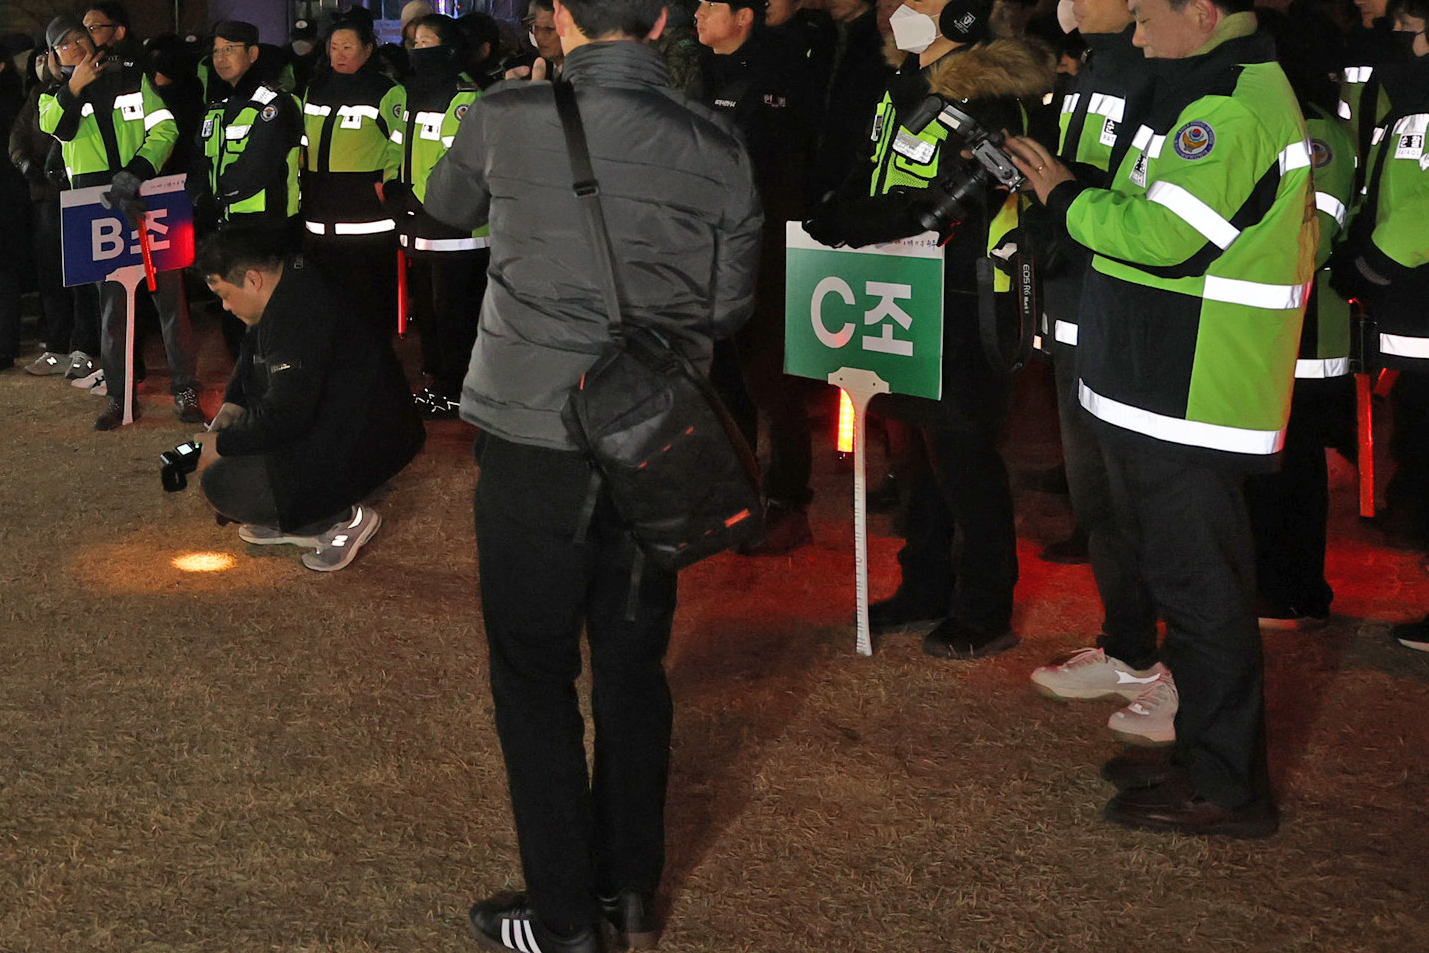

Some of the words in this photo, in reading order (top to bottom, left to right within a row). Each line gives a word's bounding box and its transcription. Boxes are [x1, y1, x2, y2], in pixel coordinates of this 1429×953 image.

[1399, 135, 1422, 148] 순찰
[92, 208, 171, 261] B조
[1022, 263, 1031, 284] EOS
[1023, 284, 1032, 296] R6
[810, 276, 914, 357] C조
